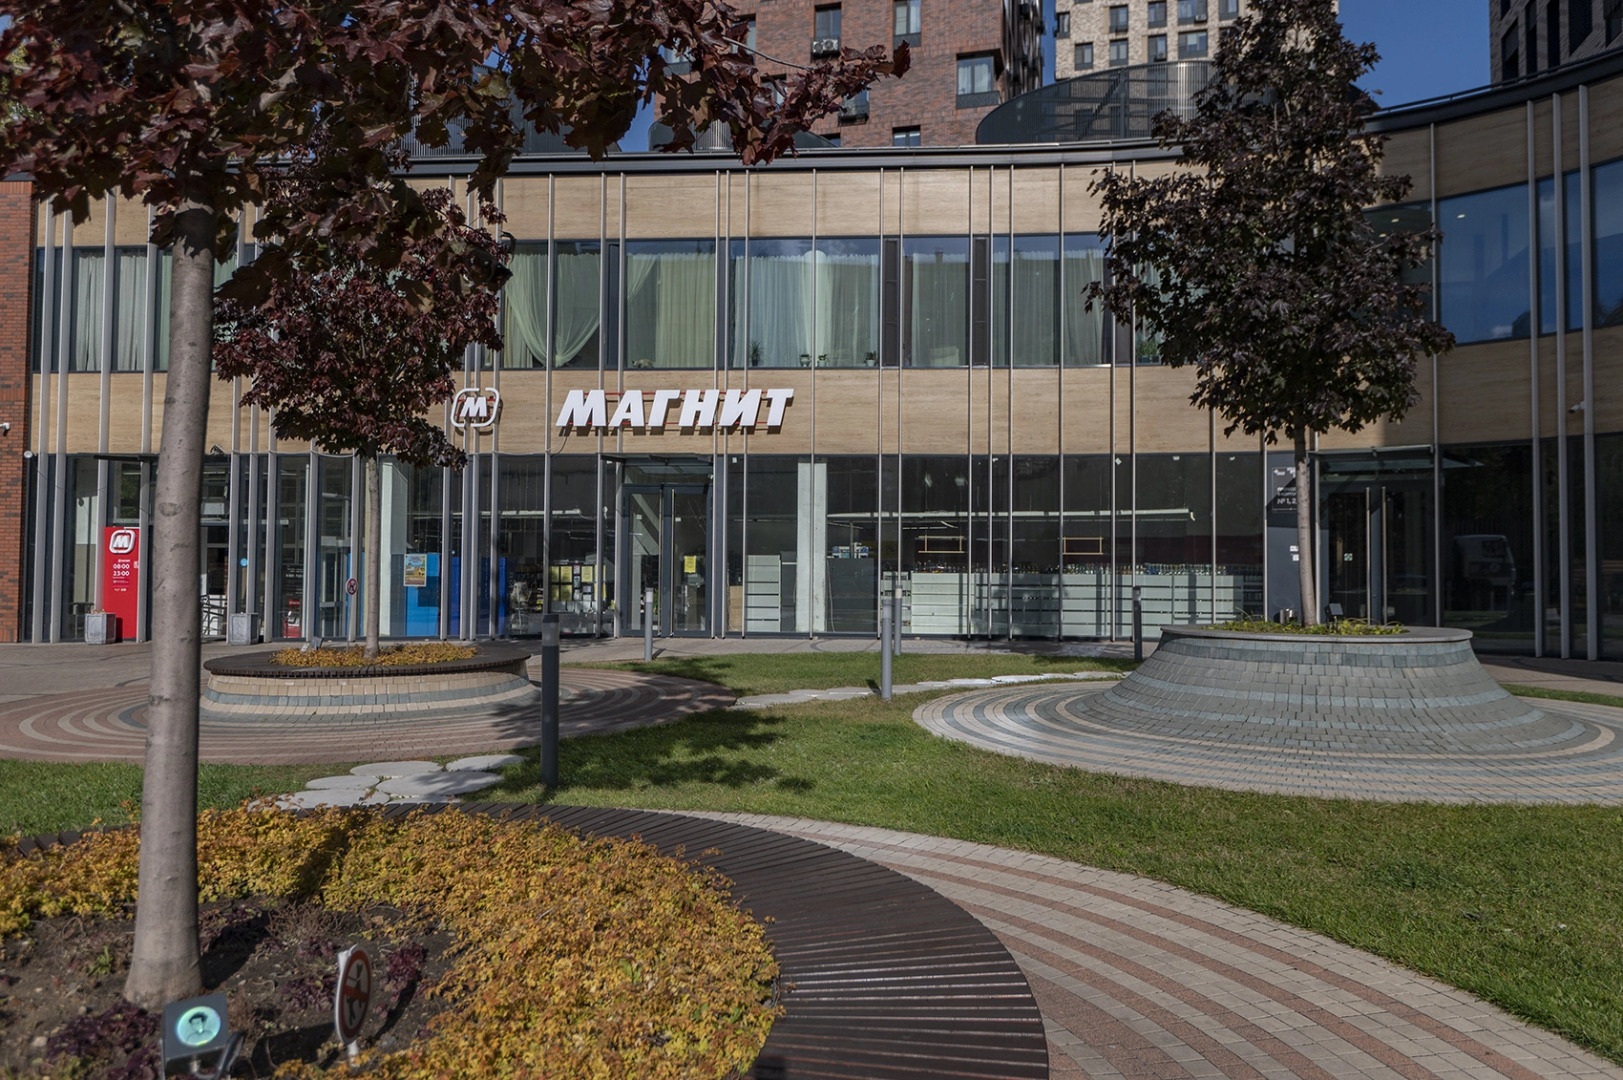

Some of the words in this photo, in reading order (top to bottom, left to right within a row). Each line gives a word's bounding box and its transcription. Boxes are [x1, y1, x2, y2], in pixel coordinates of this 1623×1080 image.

[459, 397, 488, 417] М
[555, 388, 794, 427] МАГНИТ
[113, 534, 129, 548] М
